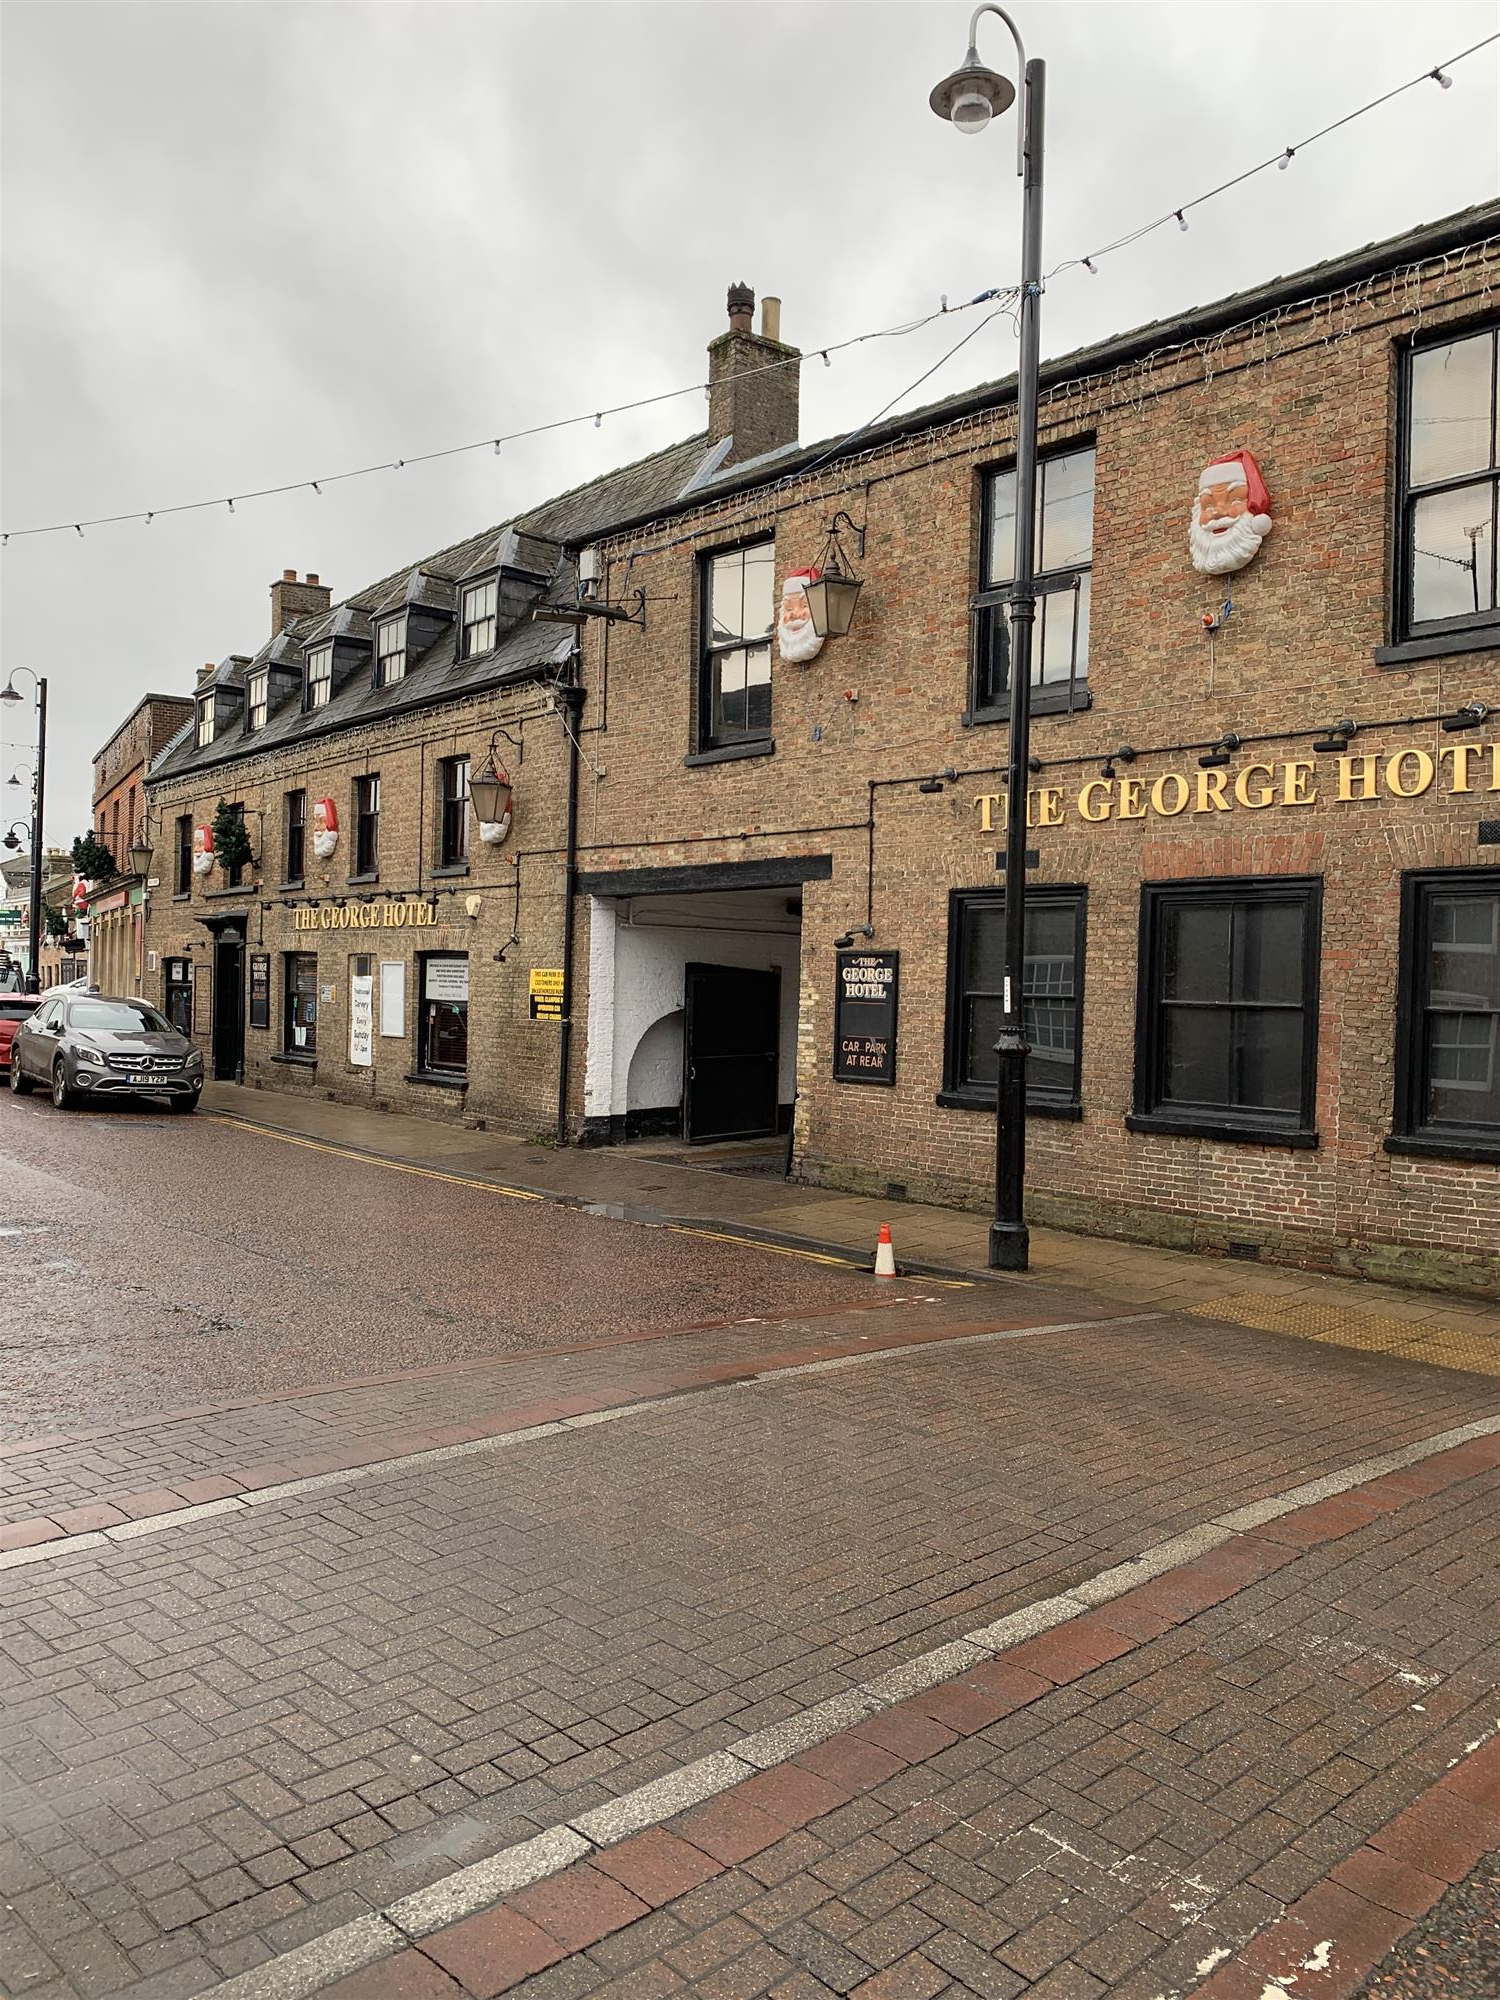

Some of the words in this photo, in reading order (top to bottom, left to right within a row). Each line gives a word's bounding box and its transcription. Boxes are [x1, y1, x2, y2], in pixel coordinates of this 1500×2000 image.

[1077, 760, 1317, 823] GEORGE
[293, 908, 319, 930] THE
[321, 904, 380, 929] GEORGE
[383, 902, 438, 927] HOTEL
[859, 957, 877, 967] THE
[842, 967, 893, 984] GEORGE
[845, 983, 887, 999] HOTEL
[353, 1029, 369, 1041] Sunday
[842, 1040, 860, 1052] CAR
[865, 1041, 887, 1054] PARK
[846, 1055, 858, 1066] AT
[859, 1055, 883, 1068] REAR
